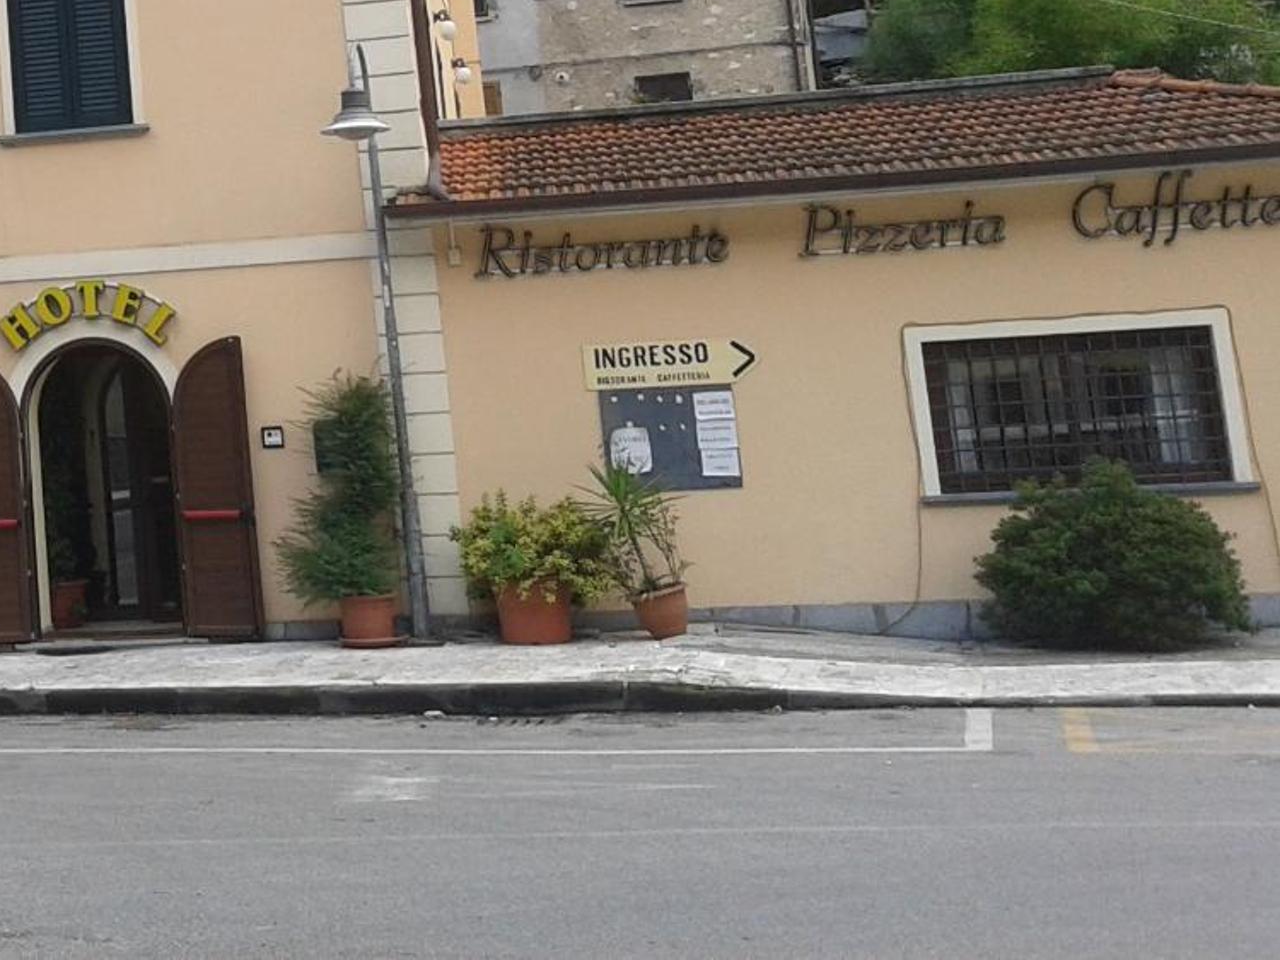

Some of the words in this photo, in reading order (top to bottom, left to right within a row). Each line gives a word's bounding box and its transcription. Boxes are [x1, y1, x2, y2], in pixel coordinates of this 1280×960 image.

[473, 221, 731, 279] Ristorante
[798, 199, 1008, 259] Pizzeria
[593, 342, 710, 370] INGRESSO
